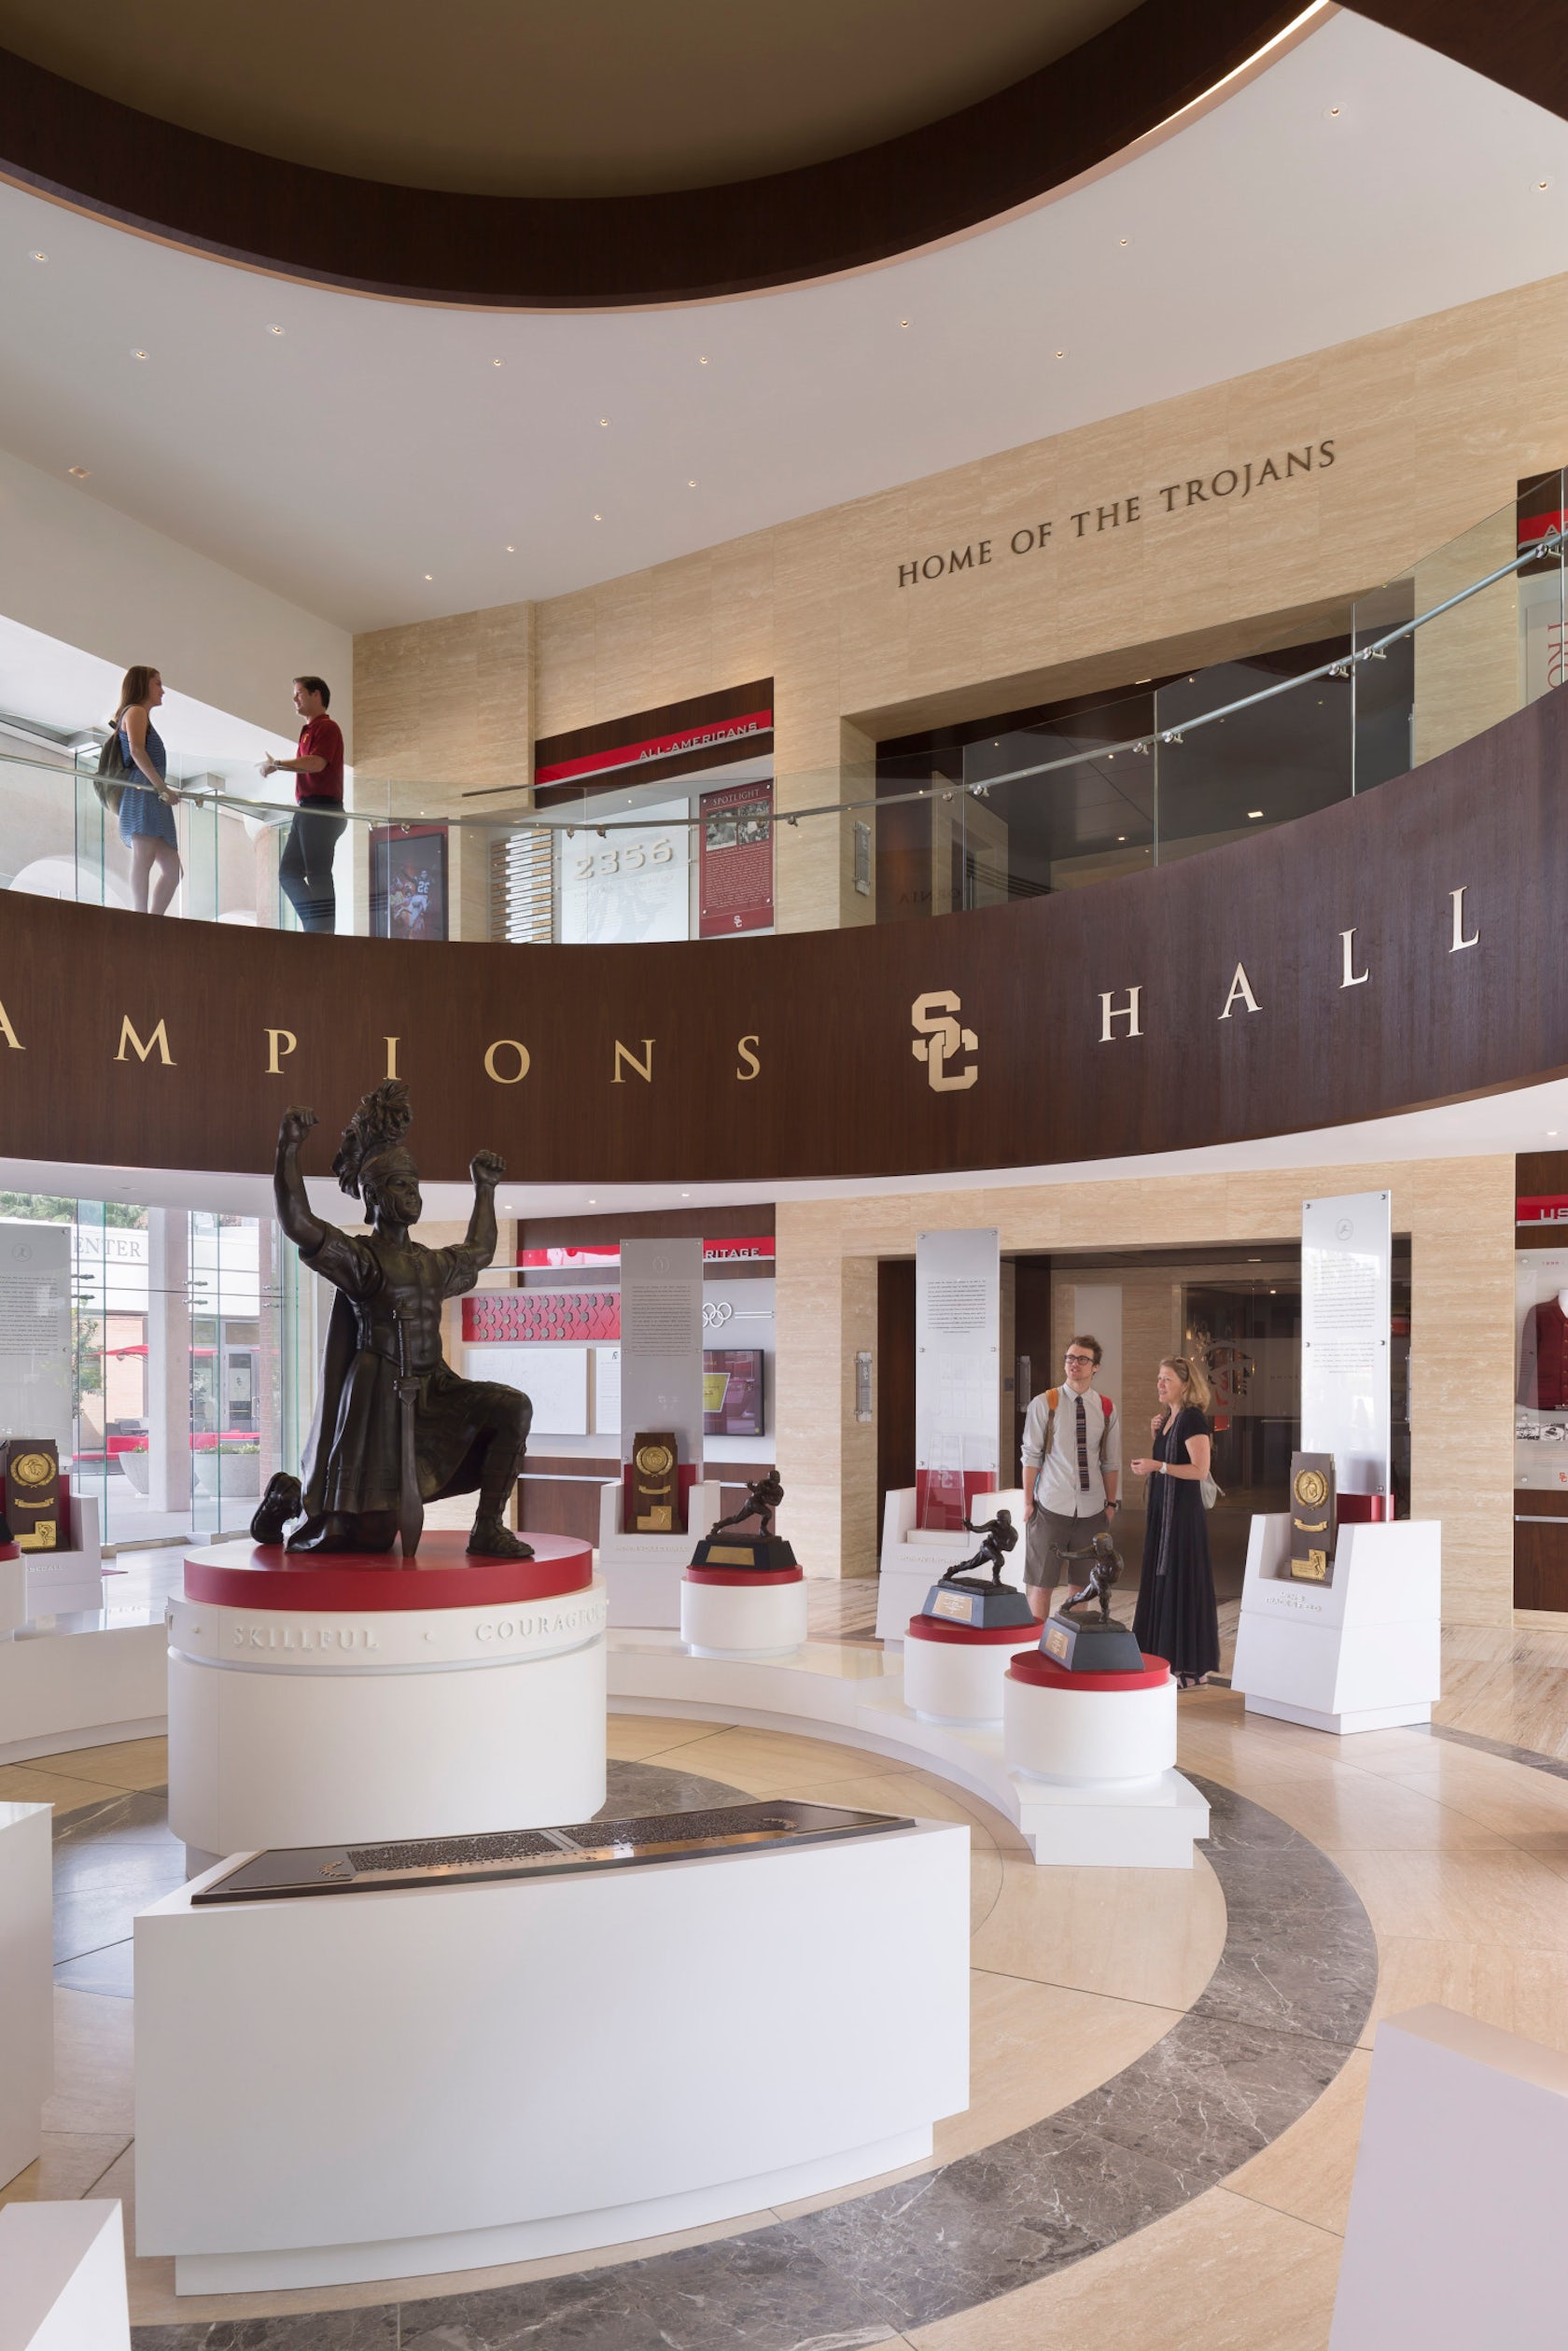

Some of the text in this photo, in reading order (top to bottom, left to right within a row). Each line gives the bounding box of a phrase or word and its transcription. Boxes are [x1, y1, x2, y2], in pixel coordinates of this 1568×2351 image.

[897, 440, 1337, 589] HOME OF THE TROJANS
[638, 721, 758, 760] ALL-AMERICANS
[712, 789, 760, 806] SPOTLIGHT
[574, 838, 674, 880] 2356
[1098, 886, 1481, 1043] HALL
[911, 990, 979, 1091] SC
[73, 1236, 141, 1257] ENTER
[706, 1248, 761, 1259] RITAGE
[233, 1627, 380, 1650] SKILLFUL
